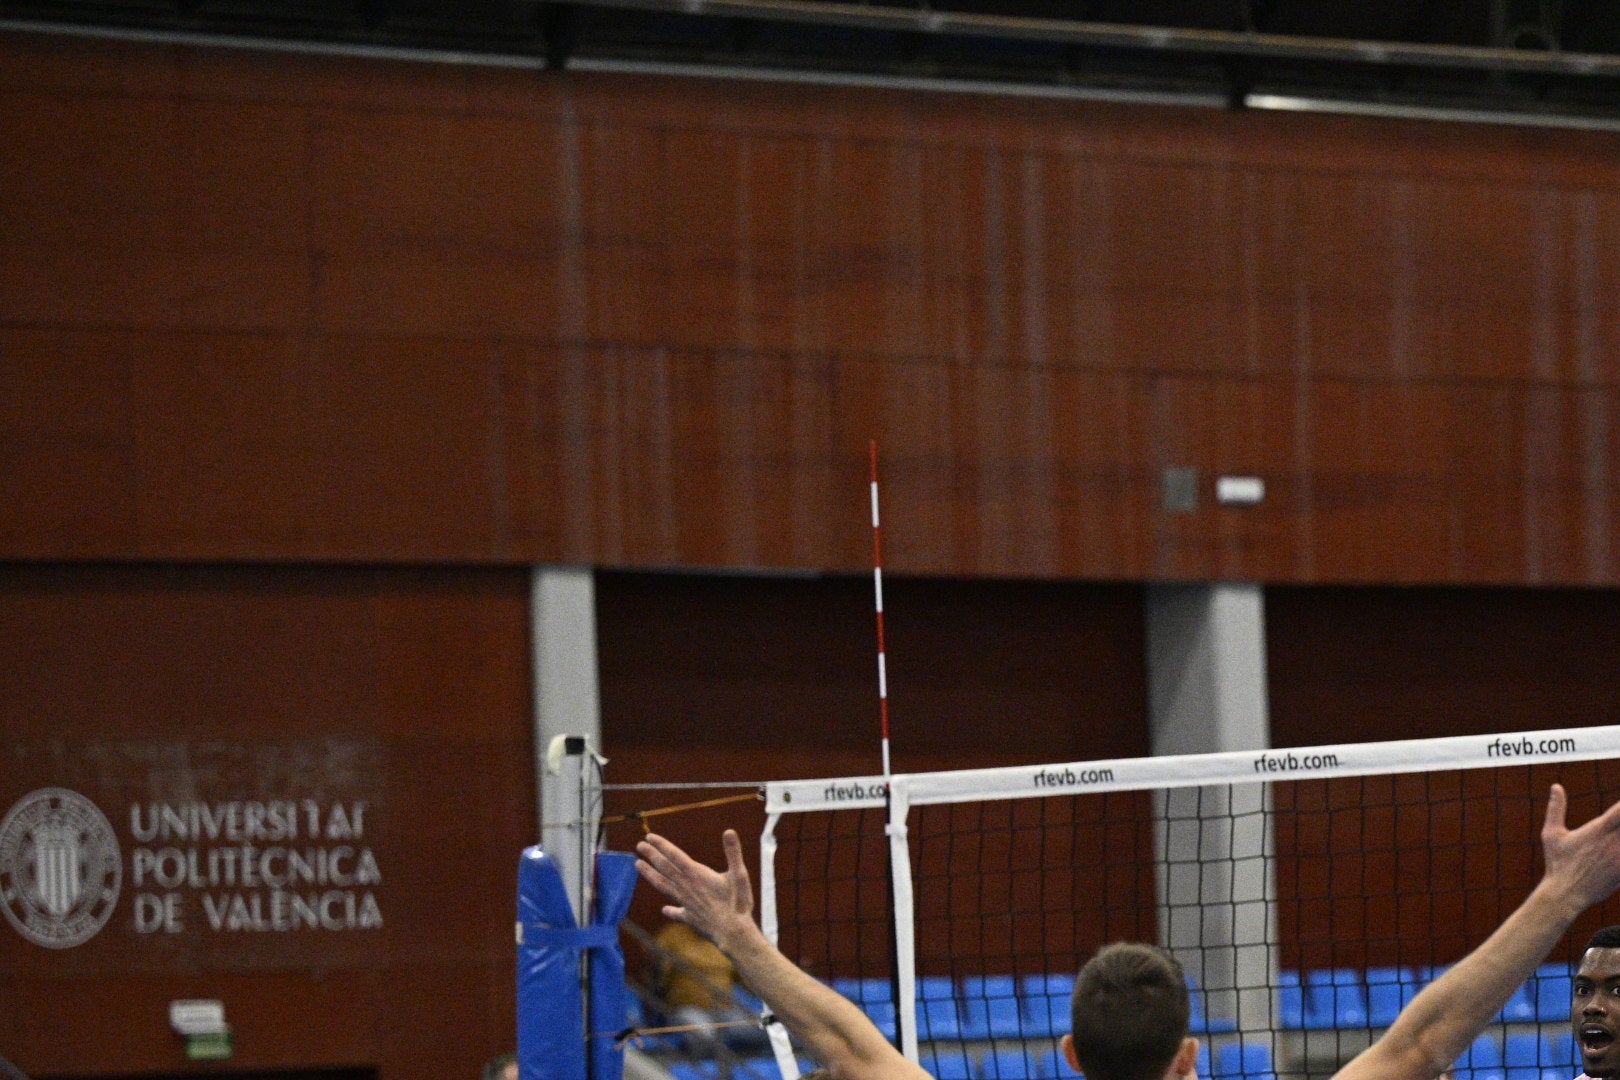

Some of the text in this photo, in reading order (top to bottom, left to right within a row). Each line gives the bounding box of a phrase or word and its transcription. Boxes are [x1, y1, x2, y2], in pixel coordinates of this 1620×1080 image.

[1487, 735, 1576, 758] rfevb.com
[1253, 751, 1339, 773] rfevb.com
[1033, 766, 1114, 789] rfevb.com
[823, 782, 890, 802] rfevb.co
[130, 800, 368, 842] UNIVERSITAT
[133, 842, 382, 888] POLITÈCNICA
[135, 892, 184, 933] DE
